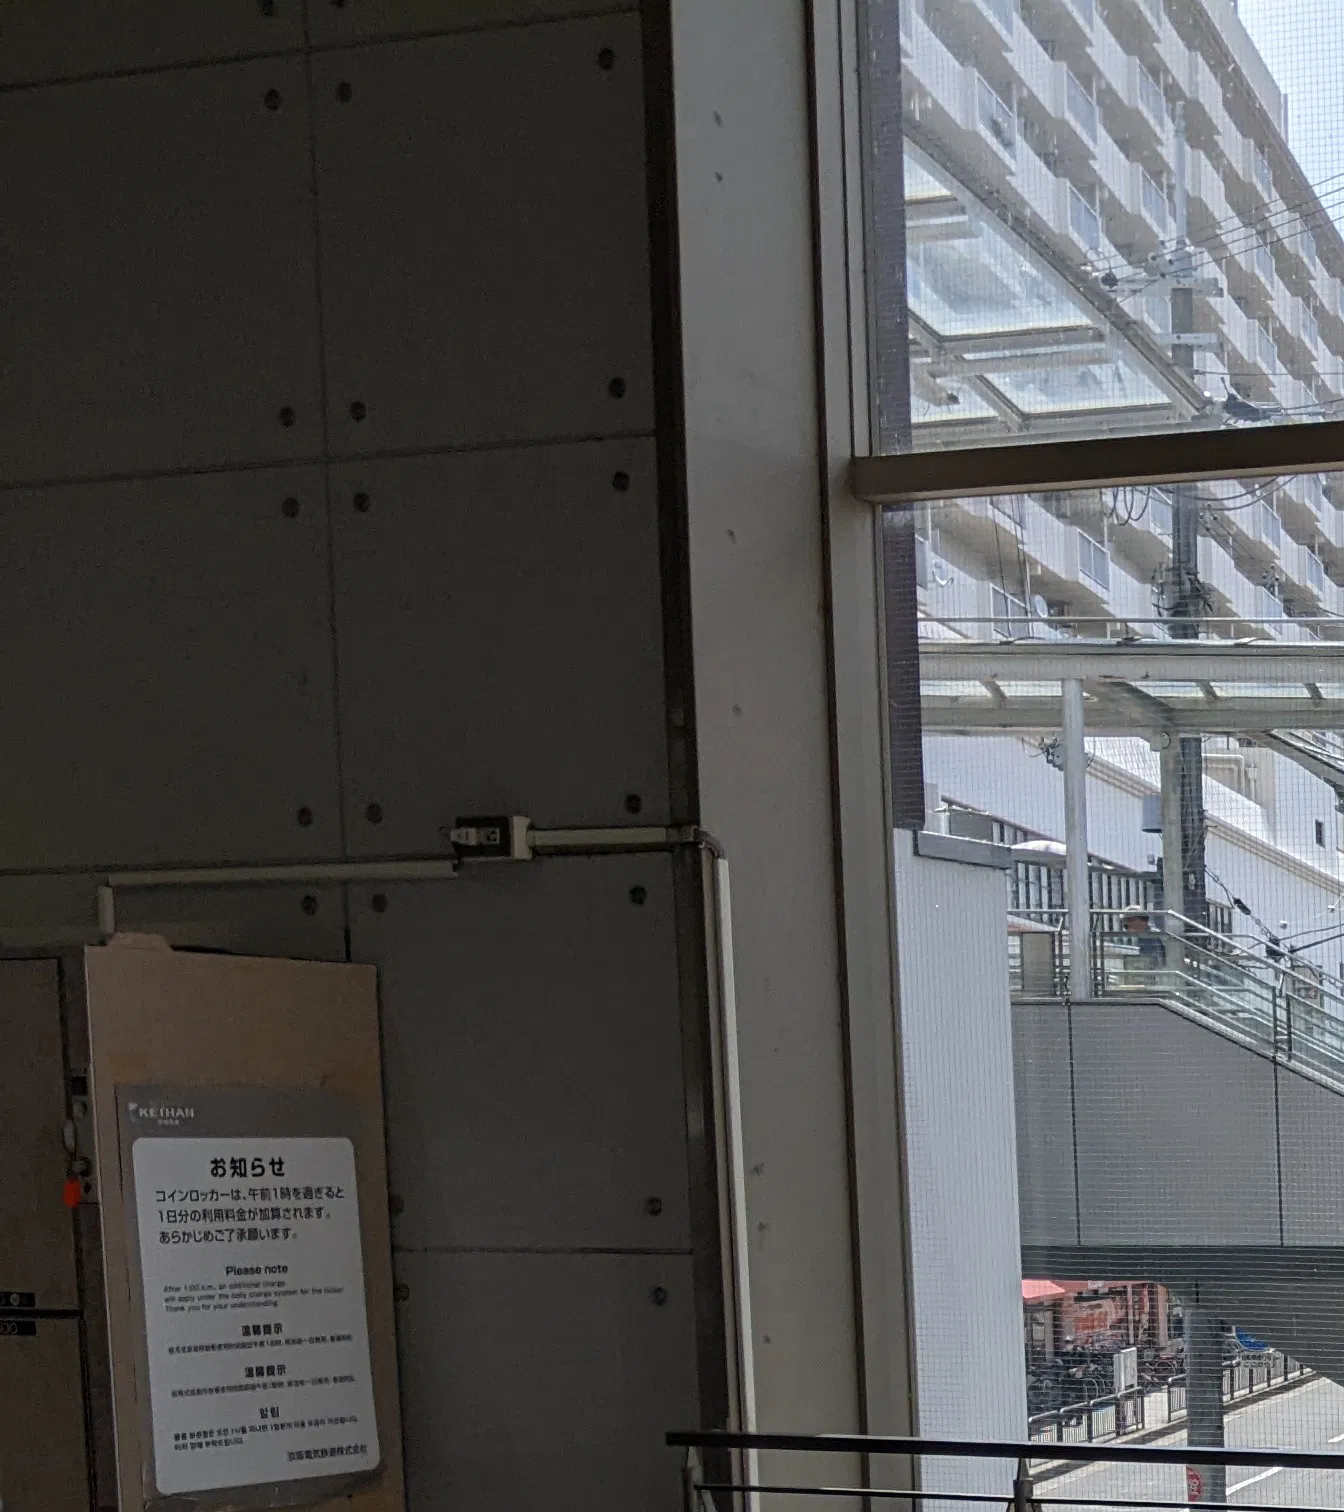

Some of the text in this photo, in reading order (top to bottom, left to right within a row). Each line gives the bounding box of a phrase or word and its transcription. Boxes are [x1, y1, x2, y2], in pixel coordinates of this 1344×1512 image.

[140, 1107, 195, 1118] KEIHAN
[210, 1157, 286, 1178] お知らせ
[226, 1264, 289, 1276] Please note
